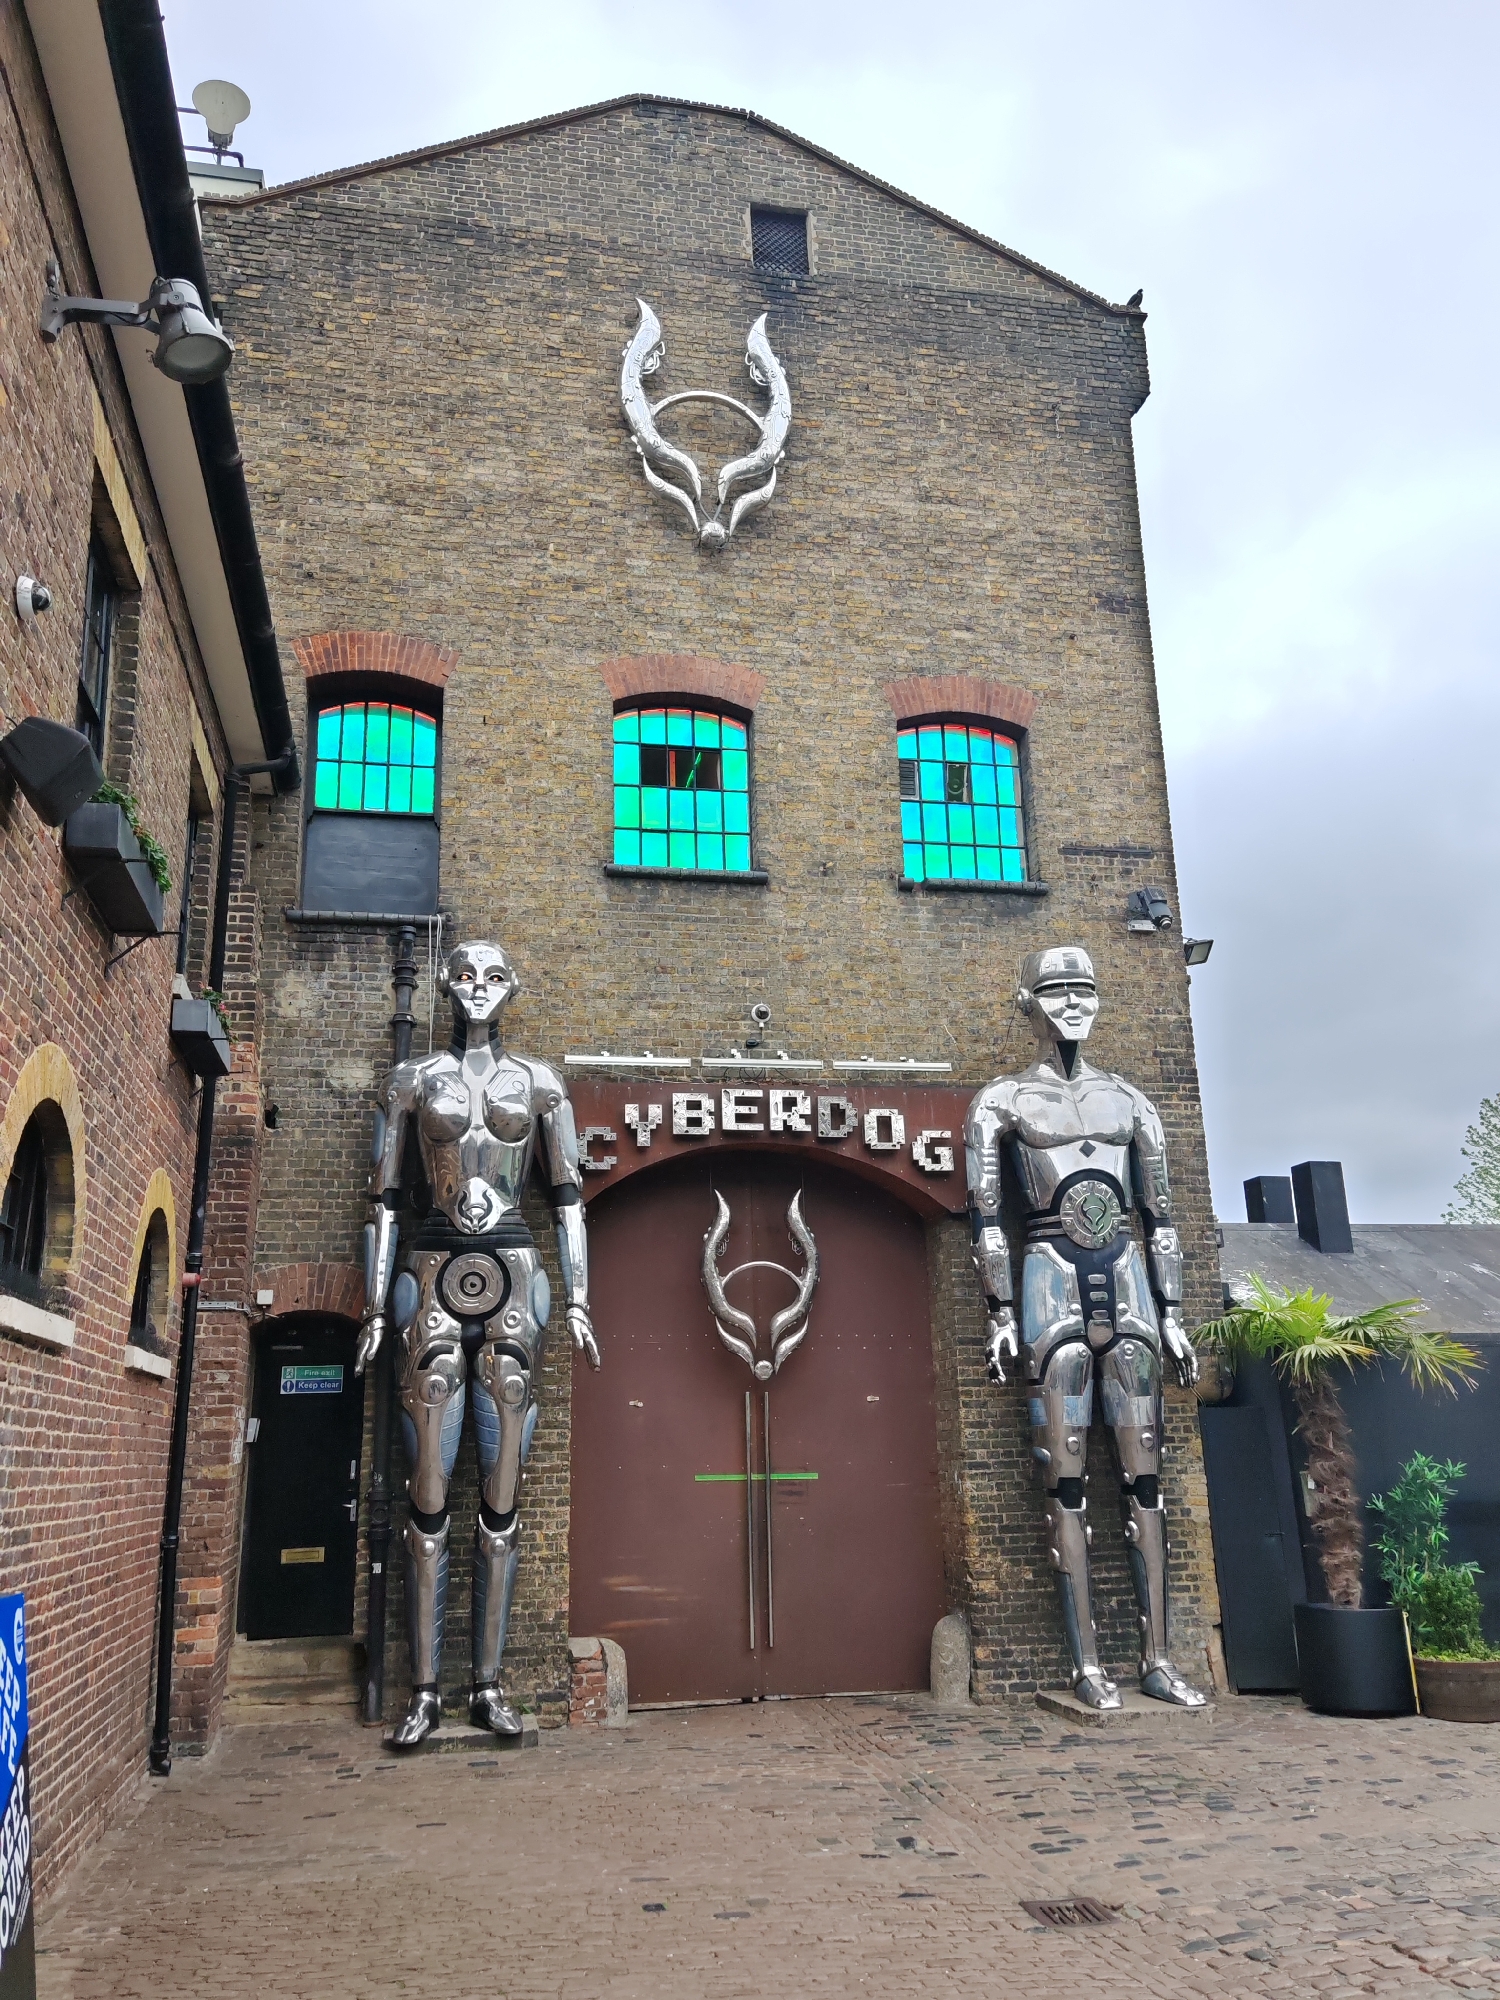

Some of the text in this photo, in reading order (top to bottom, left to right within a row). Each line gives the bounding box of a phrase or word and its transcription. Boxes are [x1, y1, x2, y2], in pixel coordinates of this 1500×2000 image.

[577, 1088, 955, 1171] CYBERDOG
[298, 1381, 340, 1389] Keep clear
